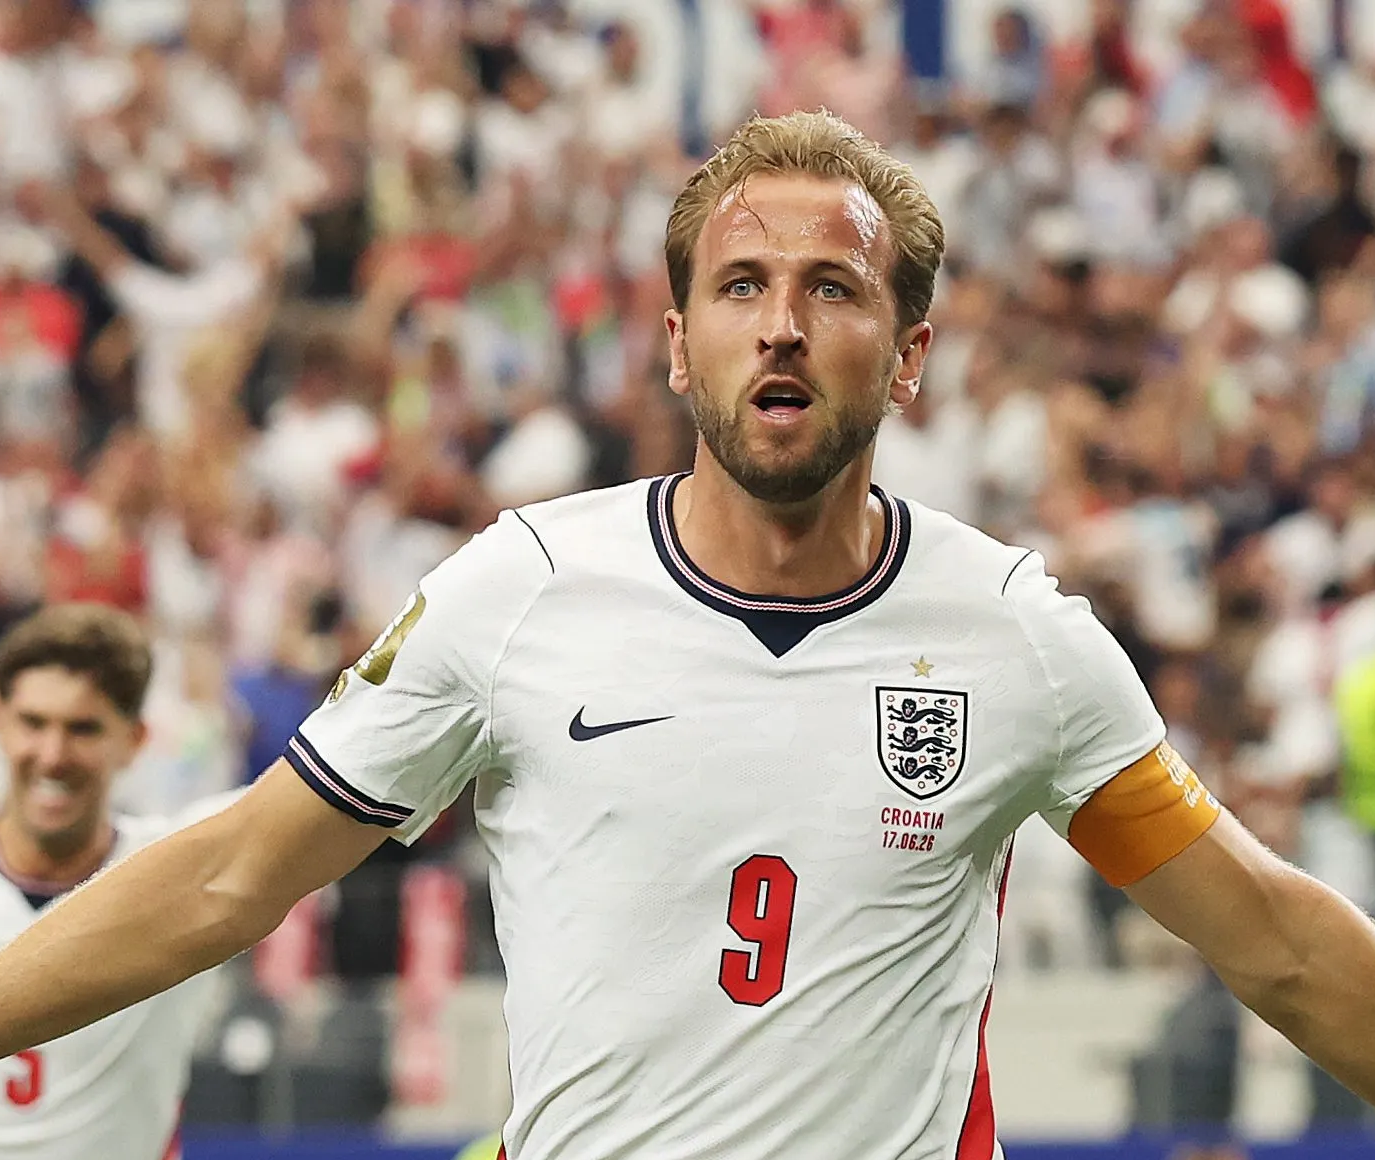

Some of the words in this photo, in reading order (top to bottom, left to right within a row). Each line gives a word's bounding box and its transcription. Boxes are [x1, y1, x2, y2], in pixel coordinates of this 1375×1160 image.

[881, 807, 944, 829] CROATIA
[883, 831, 935, 852] 17.06.26
[718, 854, 798, 1007] 9
